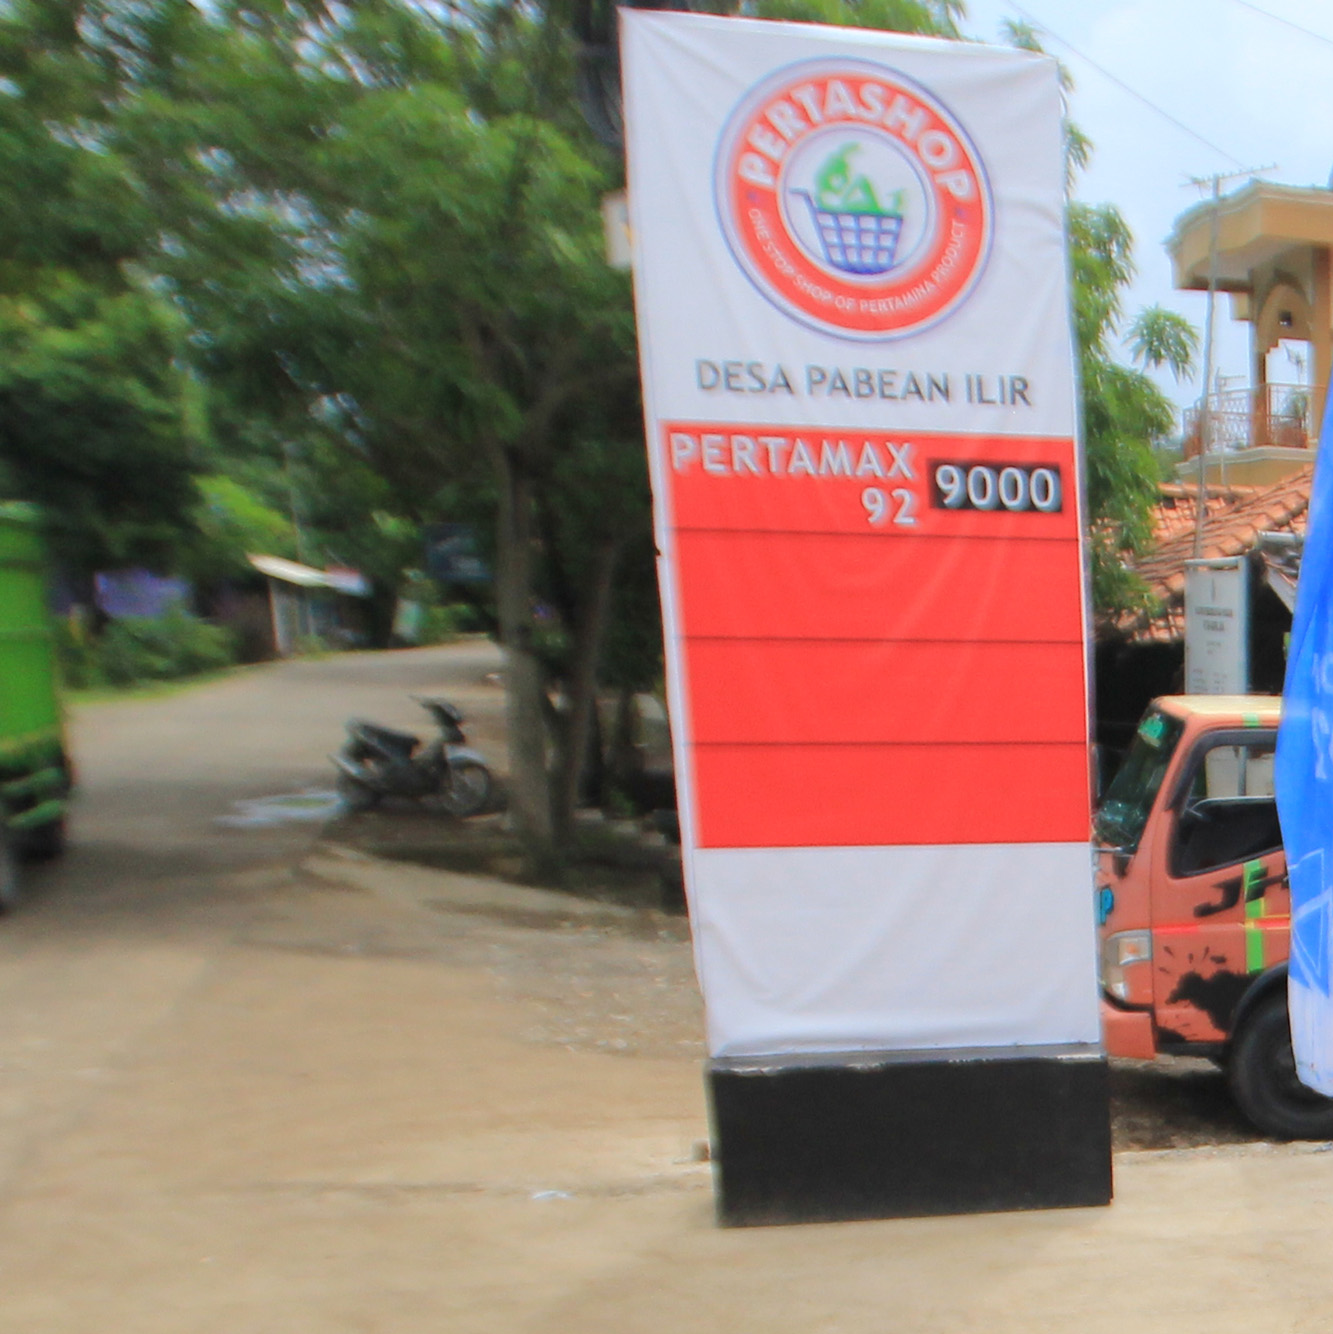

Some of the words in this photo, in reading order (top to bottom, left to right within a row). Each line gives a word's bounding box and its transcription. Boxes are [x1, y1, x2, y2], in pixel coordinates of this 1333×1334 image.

[737, 79, 972, 202] PERTASHOP
[748, 208, 769, 238] ONE
[759, 238, 796, 283] STOP
[794, 271, 834, 304] SHOP
[835, 294, 855, 312] OF
[859, 277, 936, 314] PERTAMINA
[929, 220, 967, 293] PRODUCT
[695, 359, 795, 396] DESA
[806, 365, 951, 403] PABEAN
[966, 372, 1033, 408] ILIR
[669, 432, 919, 482] PERTAMAX
[860, 487, 918, 527] 92
[934, 463, 1062, 512] 9000
